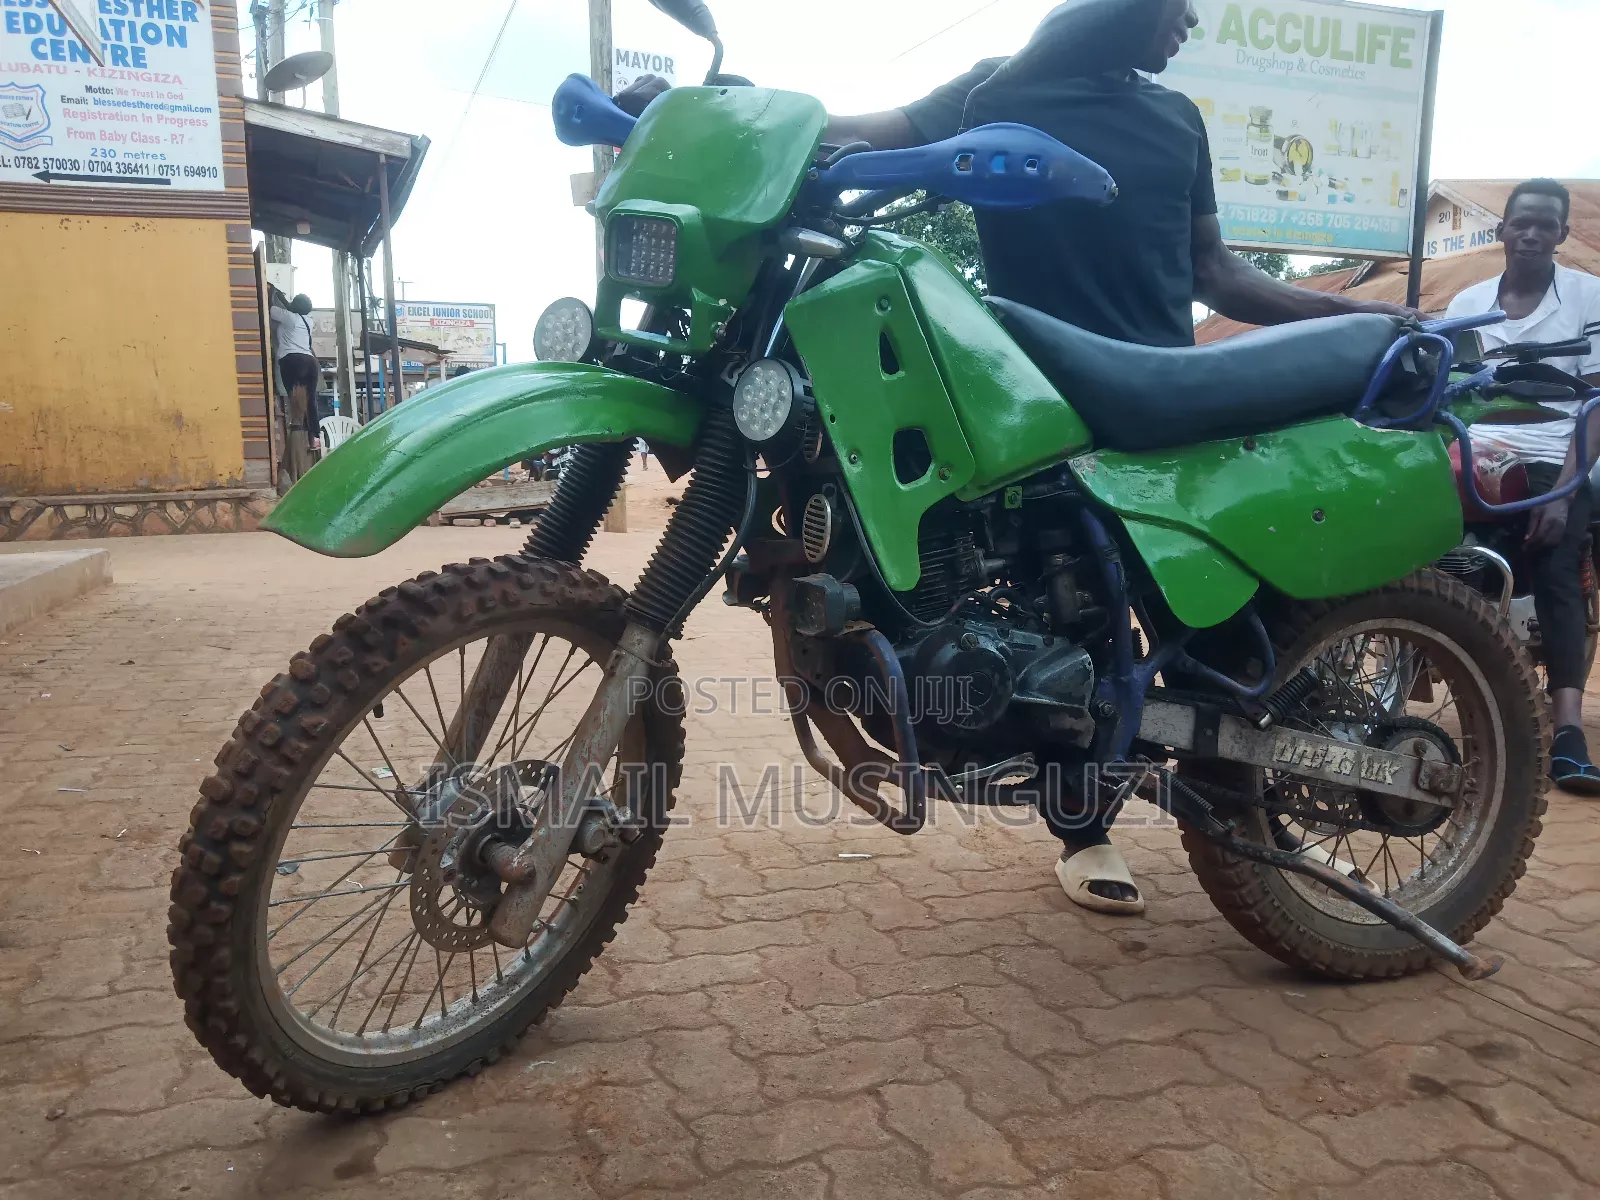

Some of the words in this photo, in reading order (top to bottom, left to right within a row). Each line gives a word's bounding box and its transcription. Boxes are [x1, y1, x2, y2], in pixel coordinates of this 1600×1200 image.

[98, 0, 199, 23] ESTHER
[5, 11, 188, 49] EDUATION
[1216, 3, 1416, 69] ACCULIFE
[616, 48, 675, 74] MAYOR
[1236, 48, 1294, 73] Drugshop
[1296, 59, 1307, 73] &
[1309, 59, 1367, 81] Cosmetics
[87, 67, 184, 85] KIZINGIZA
[84, 85, 114, 96] Motto:
[115, 87, 129, 97] We
[131, 88, 154, 99] Trust
[168, 92, 184, 101] God
[60, 95, 89, 105] Email:
[93, 97, 212, 114] blessedesthered@gmail.com
[62, 107, 139, 122] Registration
[157, 114, 209, 128] Progress
[66, 127, 97, 141] From
[99, 129, 127, 144] Baby
[130, 131, 161, 144] Class
[170, 134, 186, 145] P.7
[90, 147, 117, 159] 230
[123, 150, 167, 161] metres
[1250, 145, 1268, 157] Iron
[0, 155, 12, 168] L:
[14, 155, 40, 169] 0782
[43, 157, 80, 171] 570030
[88, 160, 113, 174] 0704
[115, 161, 150, 175] 336411
[158, 164, 181, 177] 0751
[184, 165, 218, 178] 694910
[1427, 241, 1438, 256] IS
[1442, 235, 1465, 252] THE
[407, 306, 431, 317] EXCEL
[431, 308, 461, 318] JUNIOR
[462, 309, 494, 319] SCHOOL
[433, 318, 472, 327] KIZINGIZA
